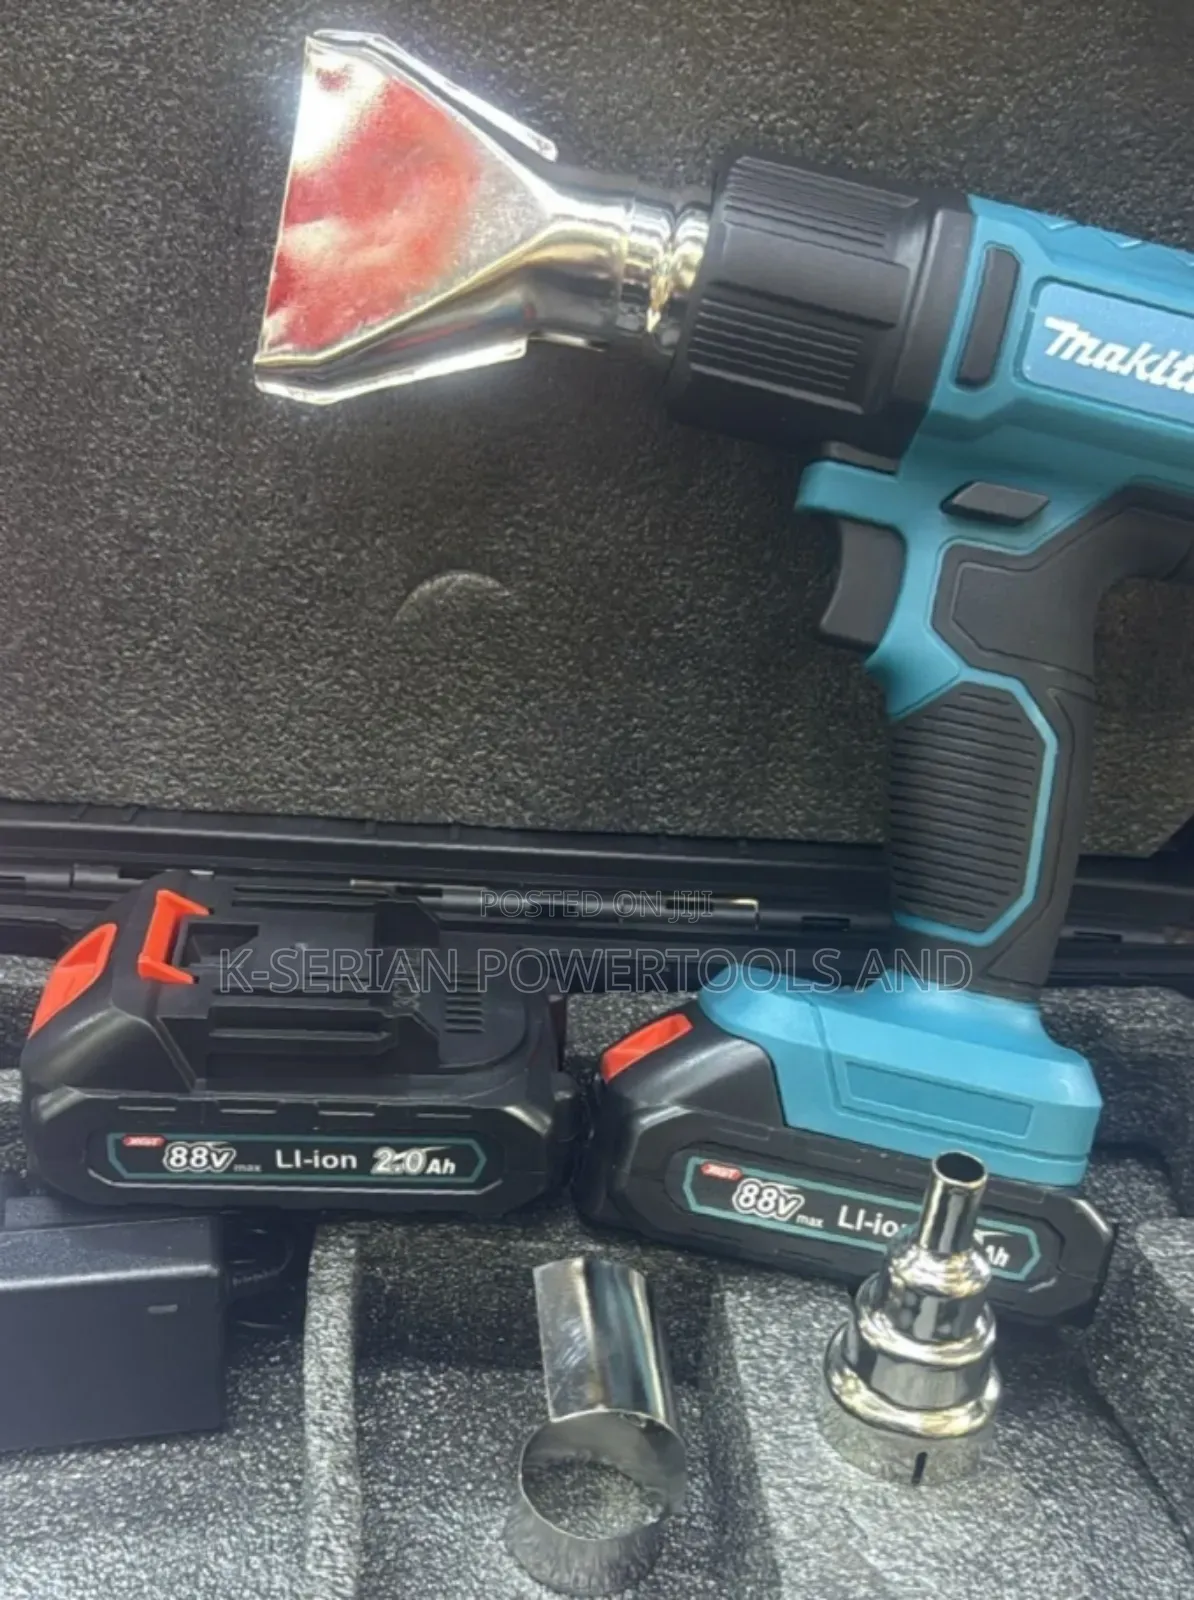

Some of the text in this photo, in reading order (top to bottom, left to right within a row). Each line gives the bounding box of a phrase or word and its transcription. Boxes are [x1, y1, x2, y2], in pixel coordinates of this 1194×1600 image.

[1044, 316, 1194, 394] Makit
[233, 1164, 262, 1173] max
[425, 1157, 456, 1174] Ah
[796, 1214, 825, 1229] max
